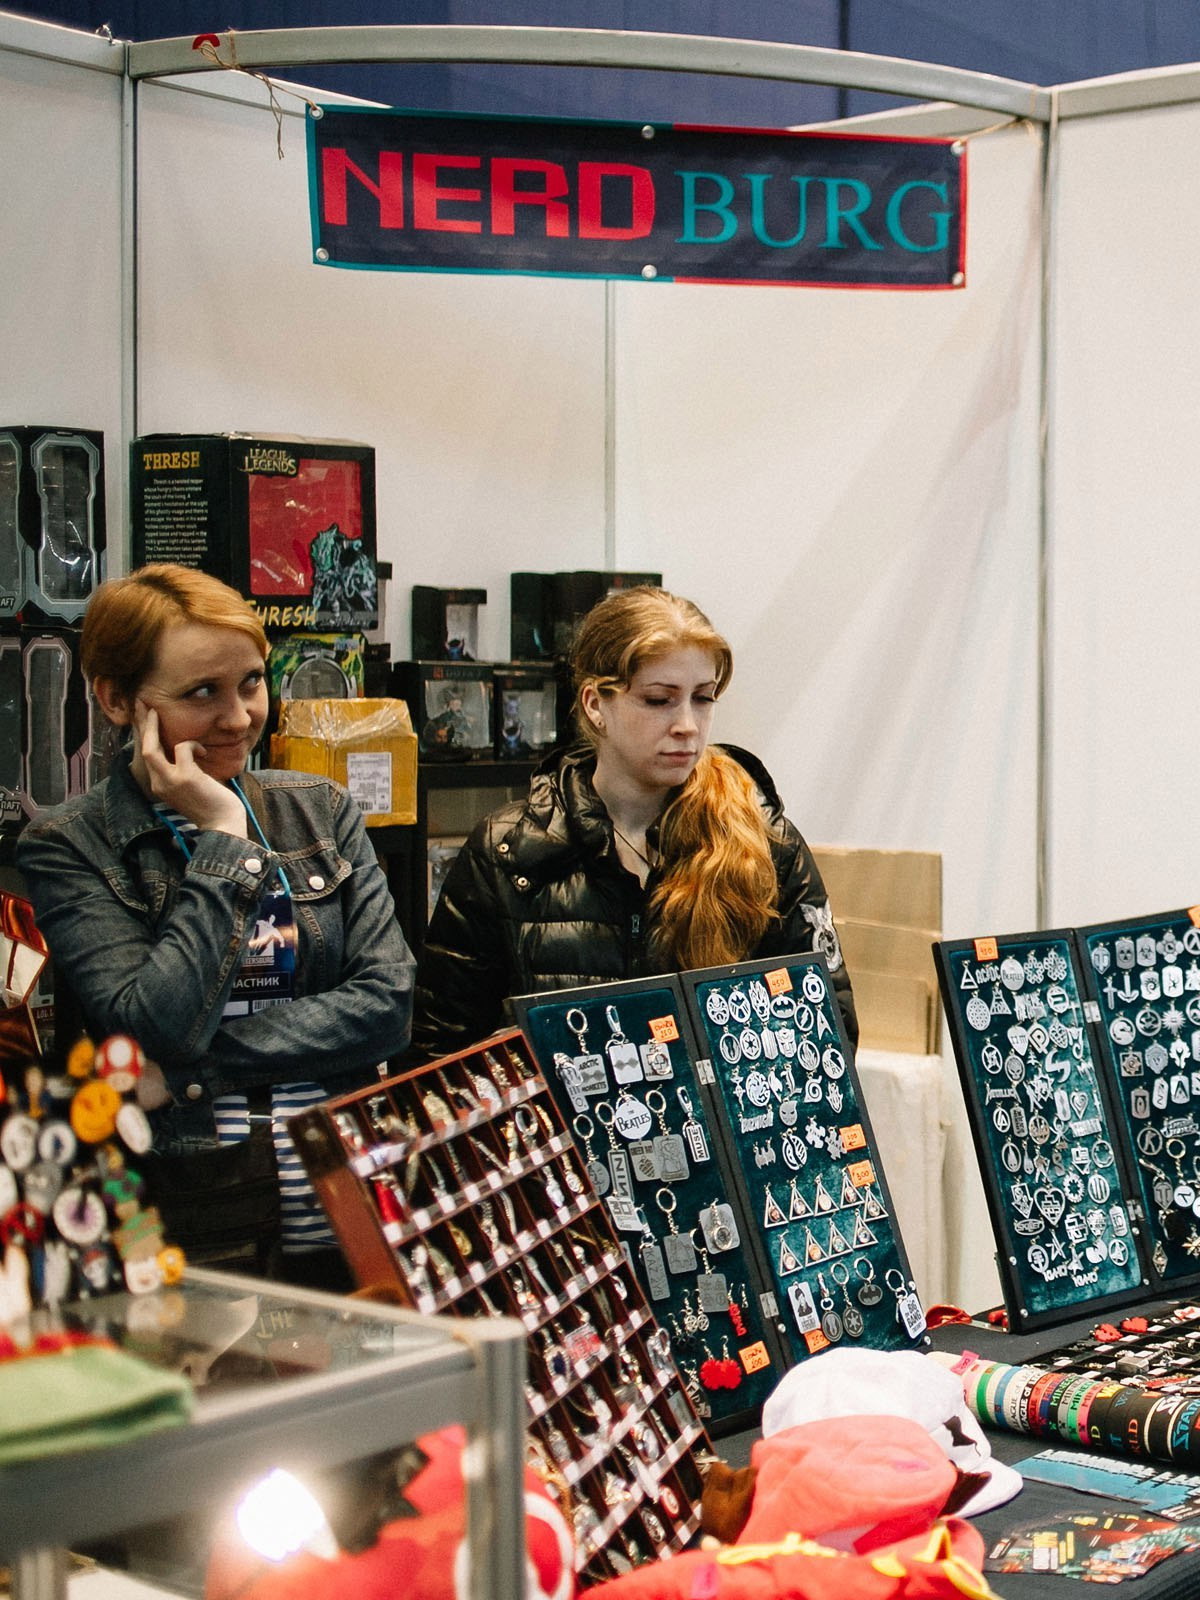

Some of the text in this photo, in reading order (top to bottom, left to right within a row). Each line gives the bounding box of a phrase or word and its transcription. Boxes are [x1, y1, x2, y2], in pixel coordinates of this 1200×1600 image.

[322, 146, 954, 253] NERD BURG
[143, 452, 200, 470] THRESH
[250, 448, 288, 459] LEAGUE
[244, 456, 297, 474] LEGENDS
[248, 600, 317, 627] HRESH
[232, 976, 280, 989] АСТНИК
[975, 965, 1001, 984] AC/DC
[579, 1058, 598, 1071] ARCTIC
[617, 1113, 651, 1131] BEATLES
[692, 1128, 704, 1159] MUSE
[908, 1309, 922, 1329] BANG
